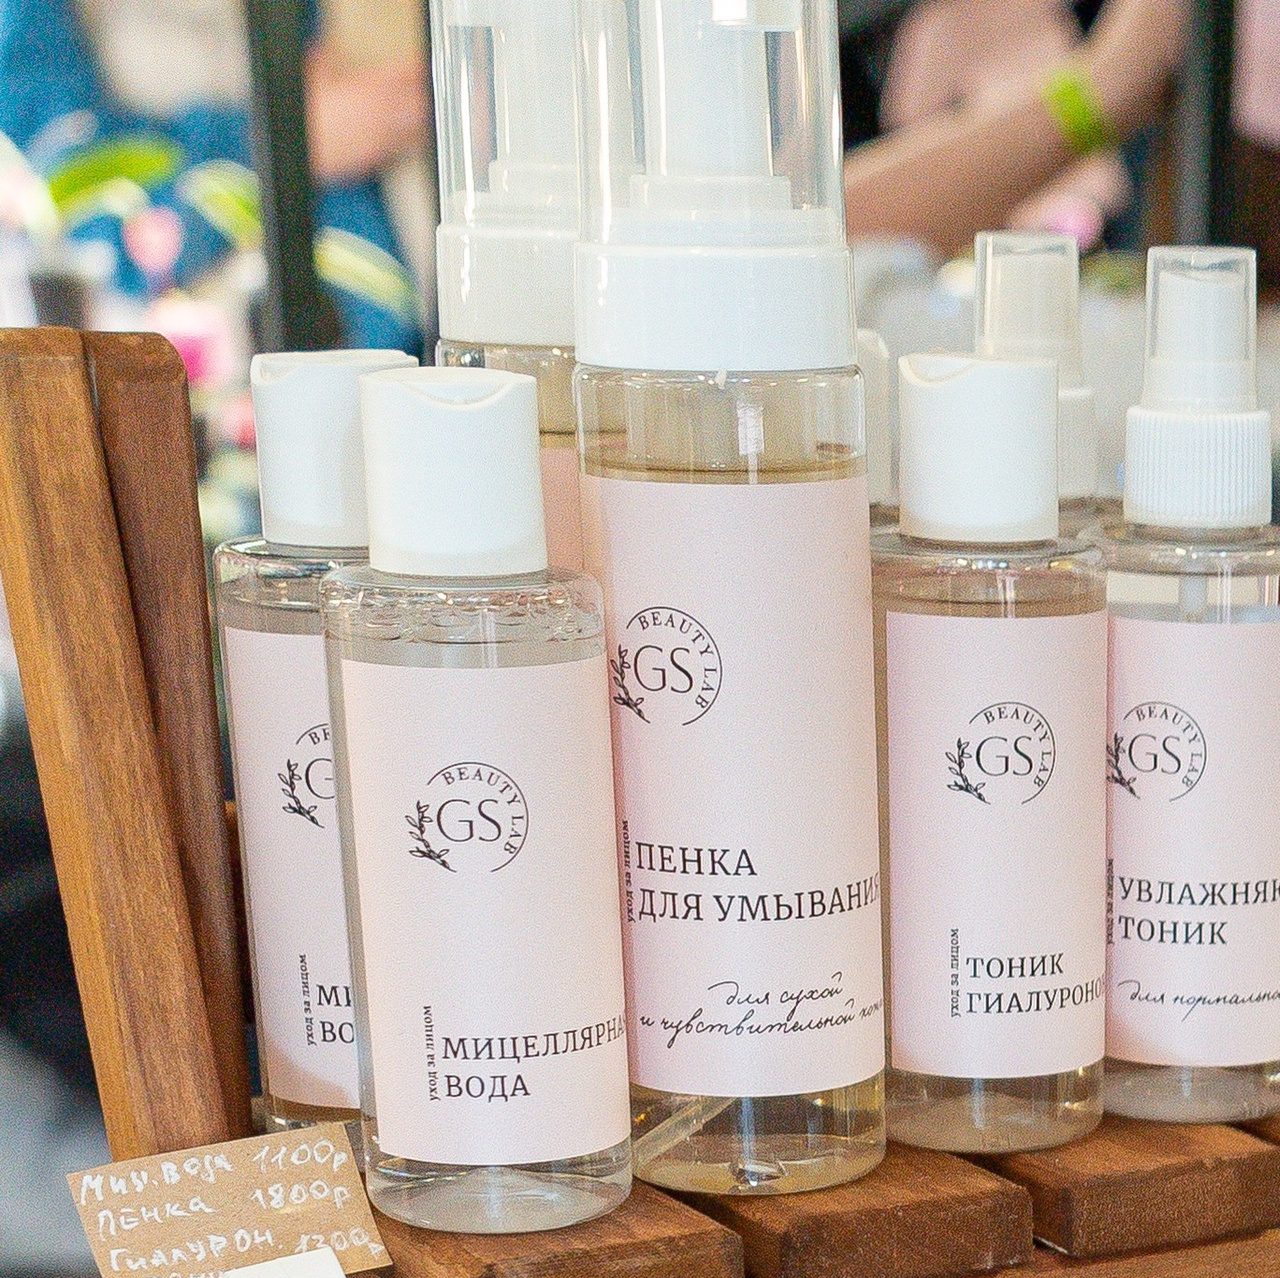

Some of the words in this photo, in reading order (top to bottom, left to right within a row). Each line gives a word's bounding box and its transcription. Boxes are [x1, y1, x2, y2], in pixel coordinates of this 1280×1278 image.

[633, 645, 694, 693] GS
[639, 611, 713, 656] BEAUTY
[695, 666, 719, 708] LAB
[976, 735, 1033, 776] GS
[984, 706, 1051, 743] BEAUTY
[1033, 751, 1052, 789] LAB
[1128, 734, 1182, 775] GS
[1134, 706, 1202, 745] BEAUTY
[1181, 752, 1203, 788] LAB
[437, 799, 501, 842] GS
[441, 767, 522, 805] BEAUTY
[503, 815, 524, 855] LAB
[635, 842, 757, 876] ПЕНКА
[639, 889, 703, 922] ДЛЯ
[713, 871, 879, 922] УМЫВАНИЯ
[1118, 916, 1227, 945] ТОНИК
[966, 953, 1064, 979] ТОНИК
[708, 981, 771, 1006] для
[779, 971, 843, 1020] сухой
[442, 1013, 626, 1062] МИЦЕЛЛЯРНА
[639, 1013, 655, 1027] и
[660, 998, 855, 1049] чувствительной
[445, 1073, 531, 1102] ВОДА
